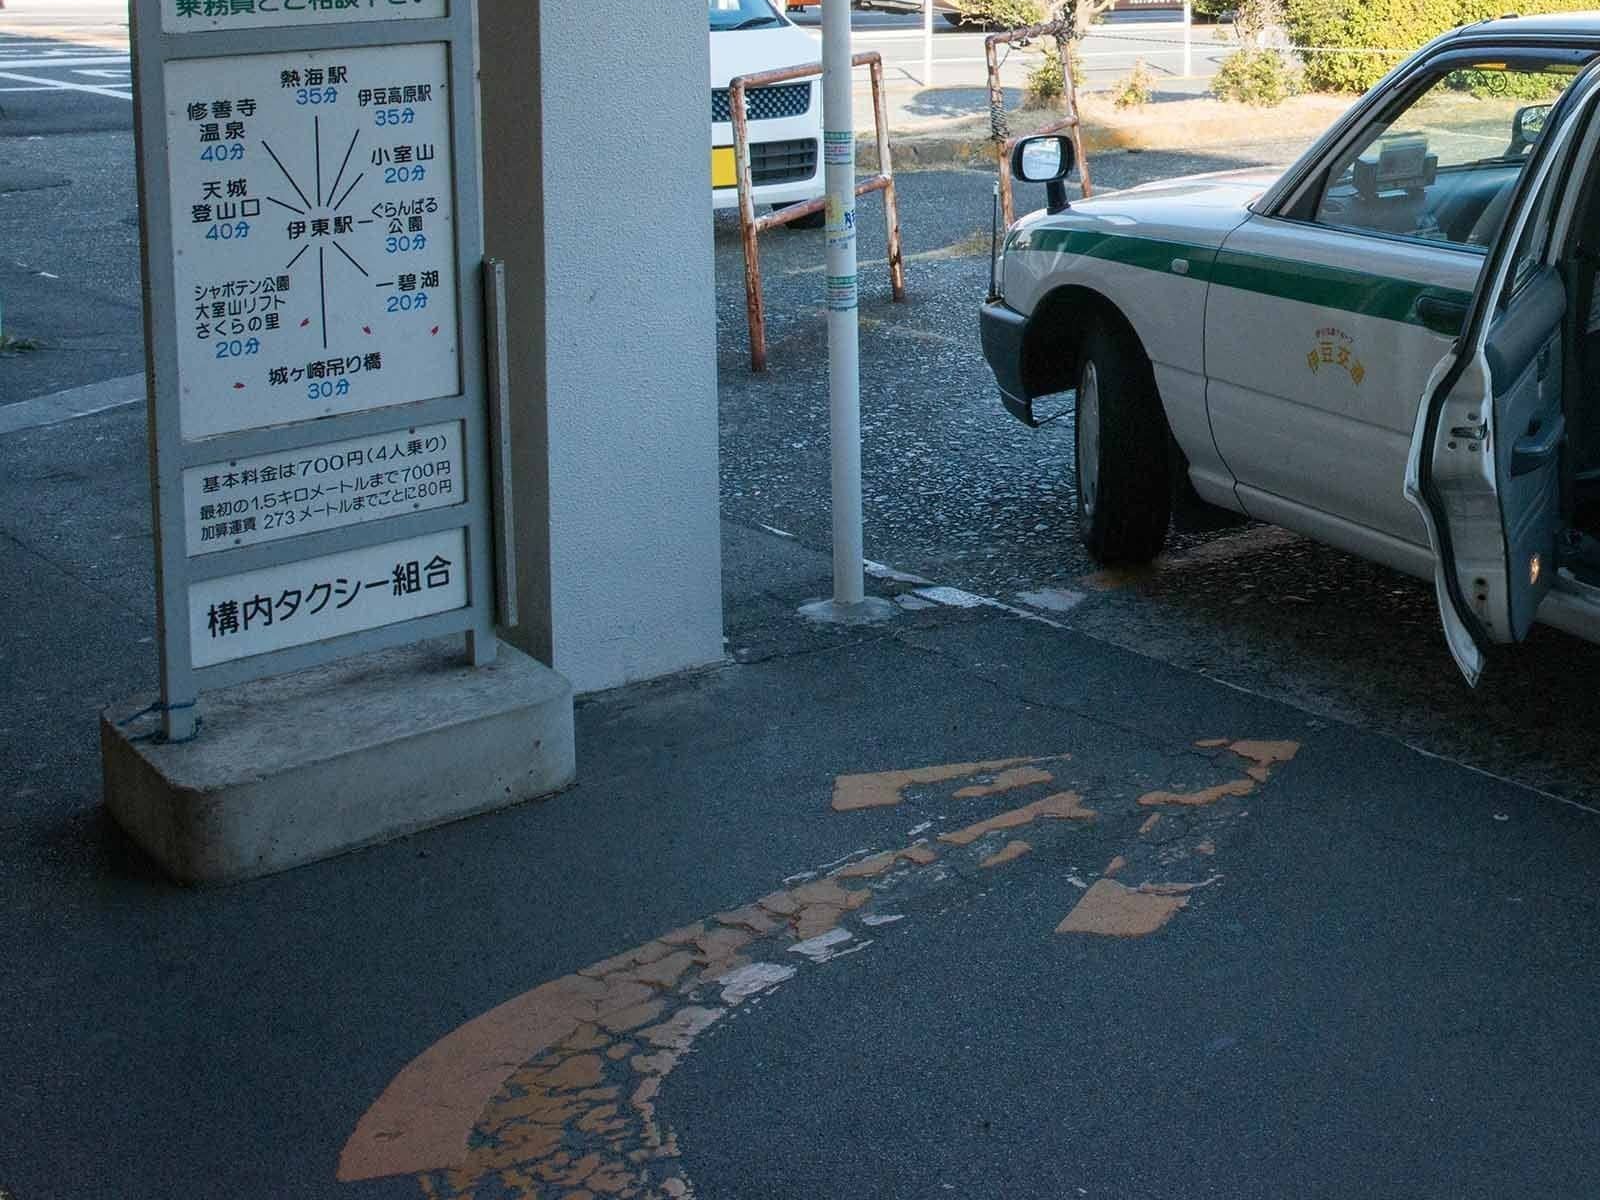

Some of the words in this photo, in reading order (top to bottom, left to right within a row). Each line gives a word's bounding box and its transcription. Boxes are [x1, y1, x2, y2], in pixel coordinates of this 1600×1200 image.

[280, 66, 349, 88] 熱海駅
[295, 87, 339, 106] 35分
[357, 84, 433, 107] 伊豆高原駅
[186, 97, 258, 121] 修善寺
[374, 107, 416, 127] 35分
[199, 121, 247, 142] 温泉
[199, 143, 246, 163] 40分
[371, 143, 435, 166] 小室山
[384, 164, 427, 185] 20分
[202, 178, 249, 201] 天城
[191, 198, 261, 224] 登山口
[205, 221, 251, 241] 40分
[287, 215, 355, 240] 伊東駅
[388, 215, 424, 234] 公園
[385, 233, 428, 254] 30分
[194, 274, 291, 302] シャボテン公園
[375, 270, 441, 293] 一碧湖
[195, 292, 287, 322] 大室山リフト
[386, 292, 429, 313] 20分
[195, 312, 281, 340] さくらの里
[215, 336, 261, 360] 20分
[307, 378, 351, 401] 30分
[201, 435, 448, 494] 基本料金は700円（4人乗り）
[199, 460, 451, 521] 最初の1.5キロメートルまで700円
[207, 555, 452, 639] 構内タクシー組合
